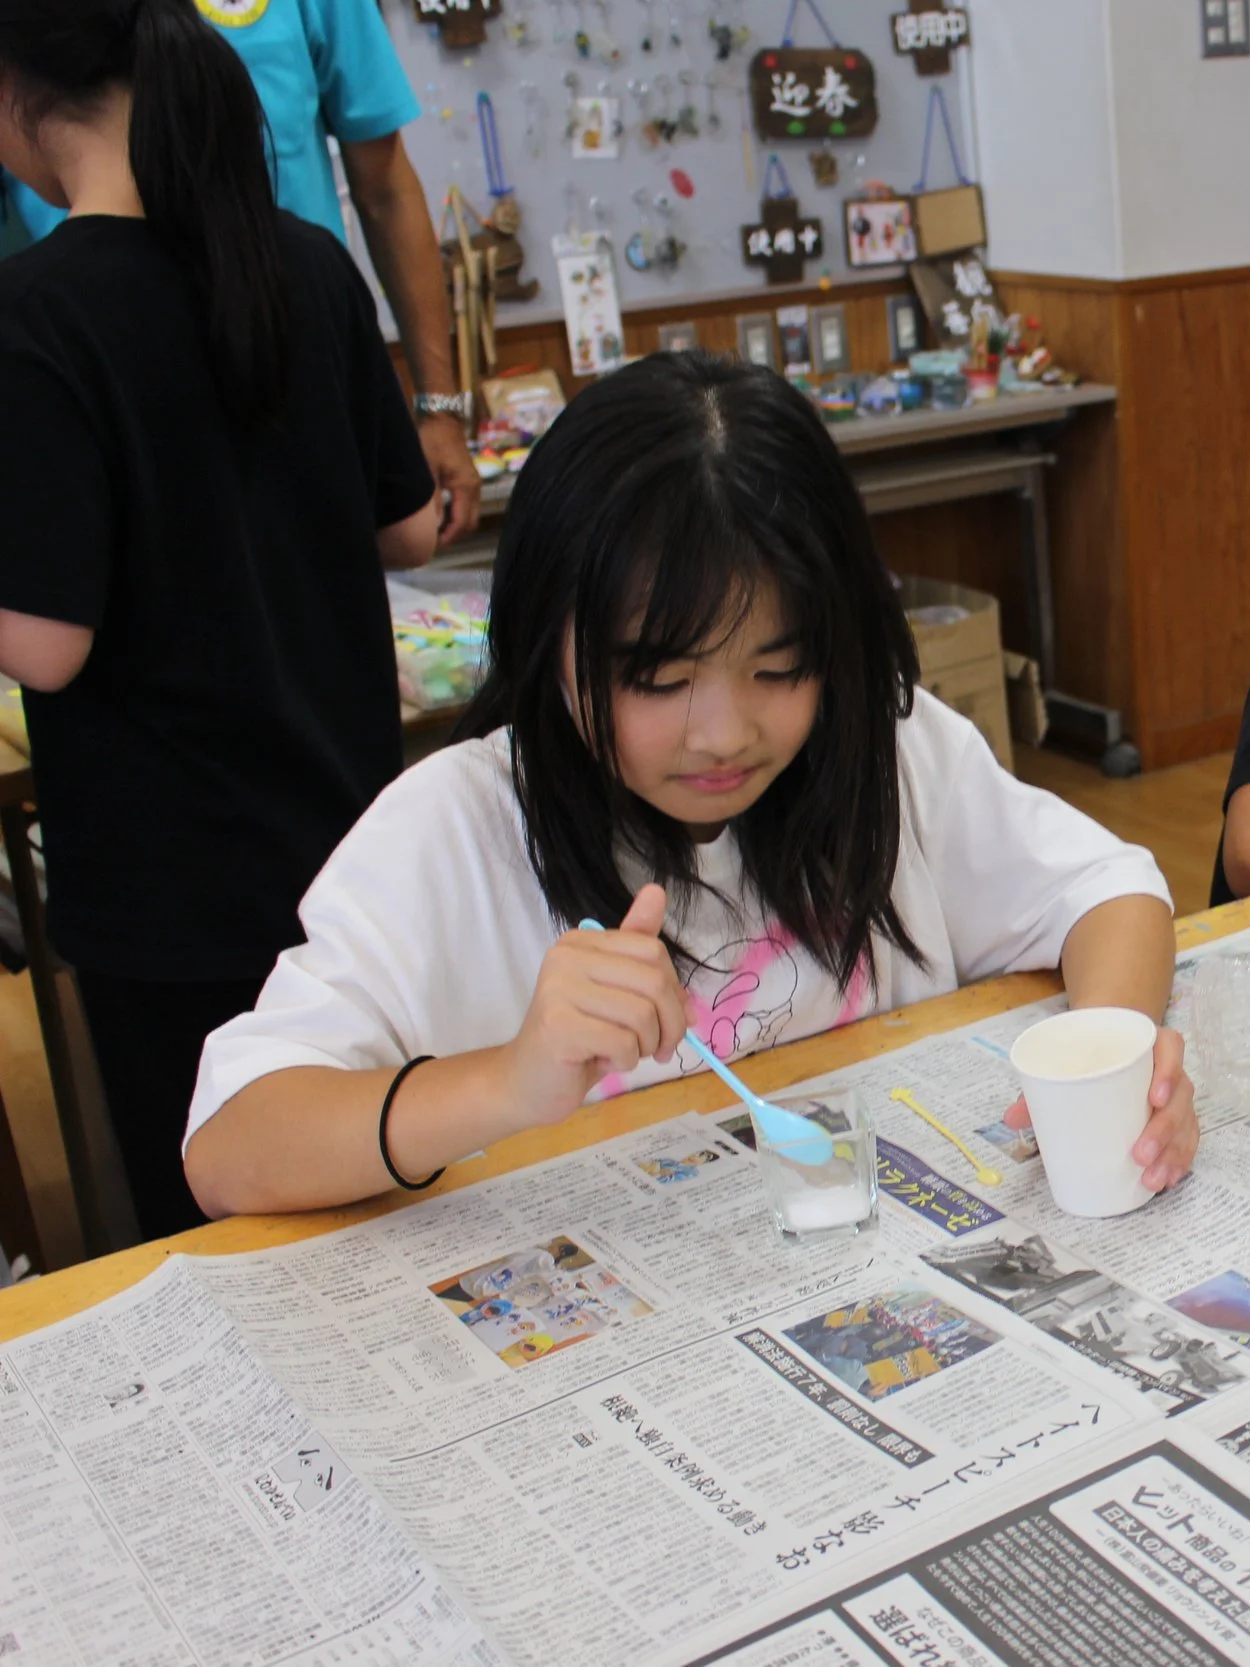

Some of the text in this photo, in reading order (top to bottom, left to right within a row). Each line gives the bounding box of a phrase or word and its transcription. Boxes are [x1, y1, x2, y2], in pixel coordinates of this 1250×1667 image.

[769, 66, 859, 117] 迎春
[869, 1605, 956, 1667] 選ばれ
